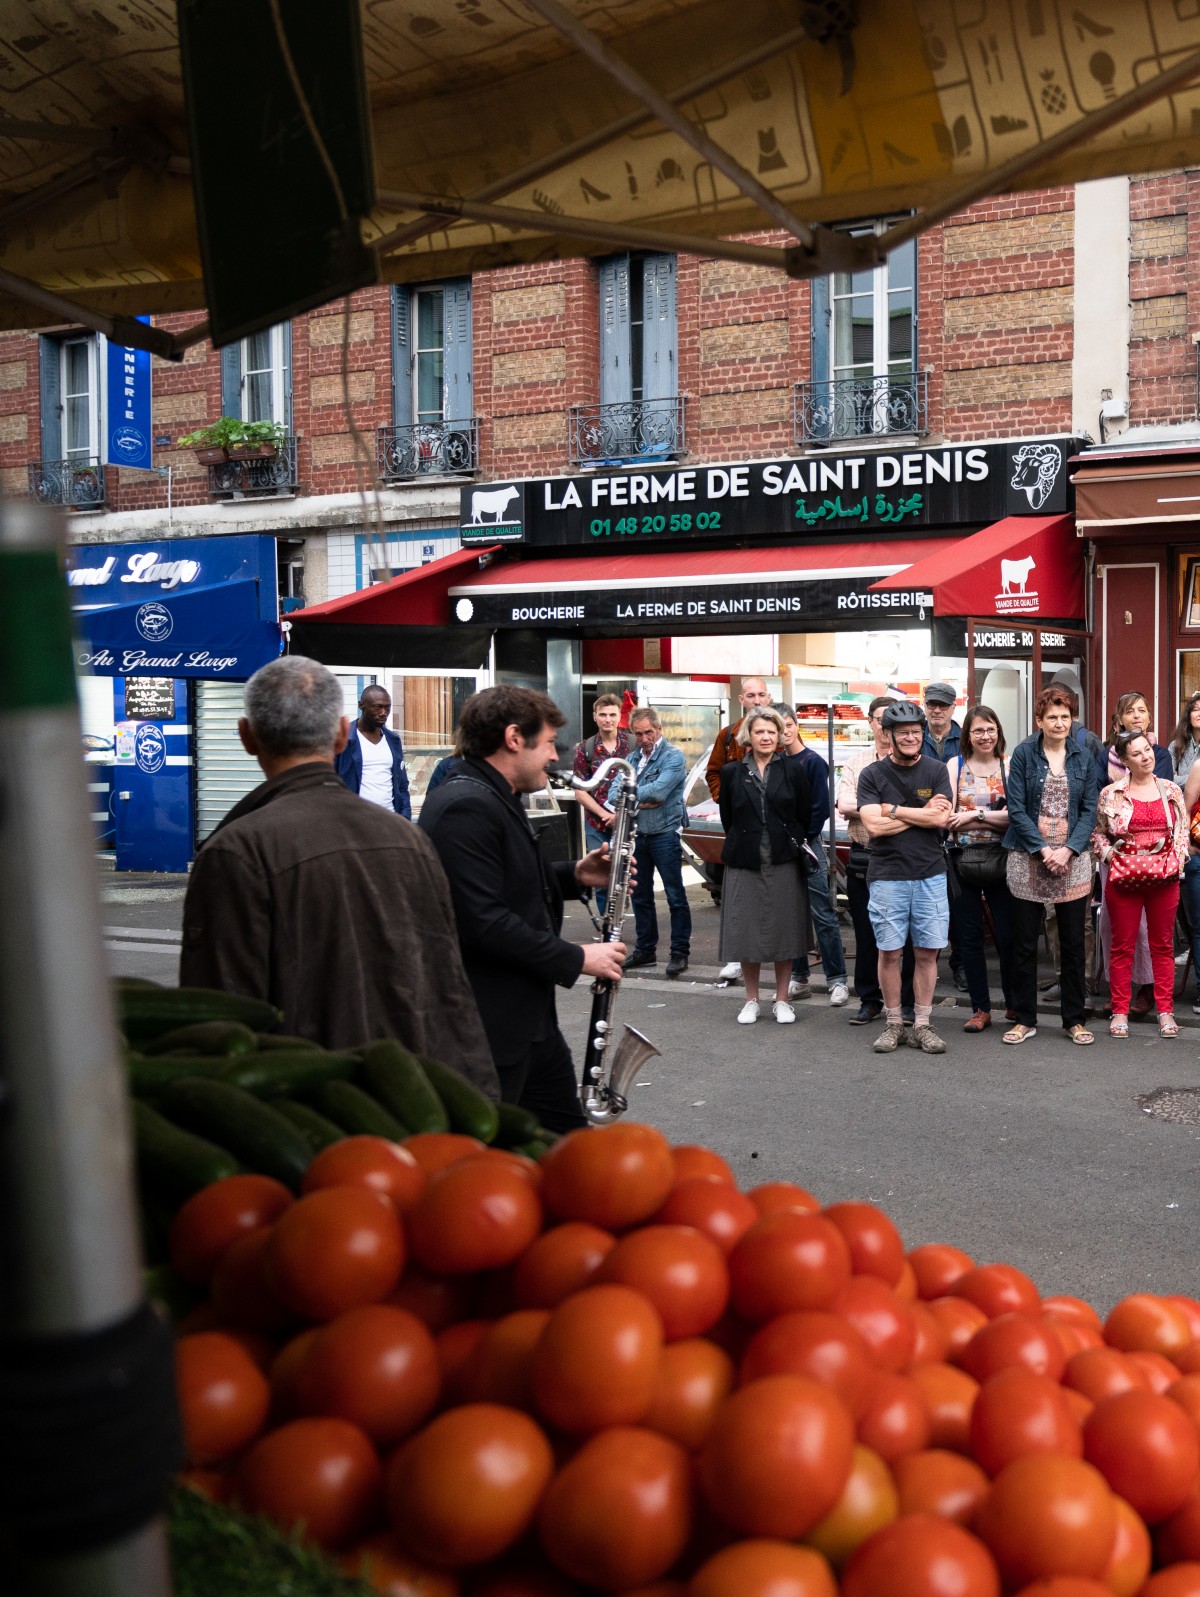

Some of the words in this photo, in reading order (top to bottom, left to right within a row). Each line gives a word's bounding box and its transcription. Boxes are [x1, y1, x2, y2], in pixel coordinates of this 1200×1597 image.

[124, 346, 135, 420] NNERIE
[544, 480, 583, 511] LA
[591, 471, 697, 508] FERME
[707, 465, 750, 499] DE
[762, 457, 866, 496] SAINT
[876, 448, 990, 488] DENIS
[794, 495, 869, 526] إسلامية
[874, 492, 924, 523] مجزرة
[461, 528, 486, 537] VIANDE
[486, 527, 494, 535] DE
[590, 518, 611, 537] 01
[615, 516, 637, 535] 48
[641, 515, 666, 533] 20
[670, 512, 692, 532] 58
[696, 511, 721, 530] 02
[425, 546, 431, 554] 3
[68, 556, 118, 587] and
[511, 605, 585, 621] BOUCHERIE
[616, 604, 635, 618] LA
[637, 601, 683, 617] FERME
[687, 601, 706, 615] DE
[710, 598, 753, 614] SAINT
[756, 597, 802, 612] DENIS
[837, 591, 925, 609] RÔTISSERIE
[995, 600, 1013, 609] VIANDE
[1013, 599, 1021, 607] DE
[1021, 632, 1066, 647] ROSSERIE
[78, 650, 115, 666] Au
[119, 650, 184, 672] Grand
[184, 651, 238, 671] Large
